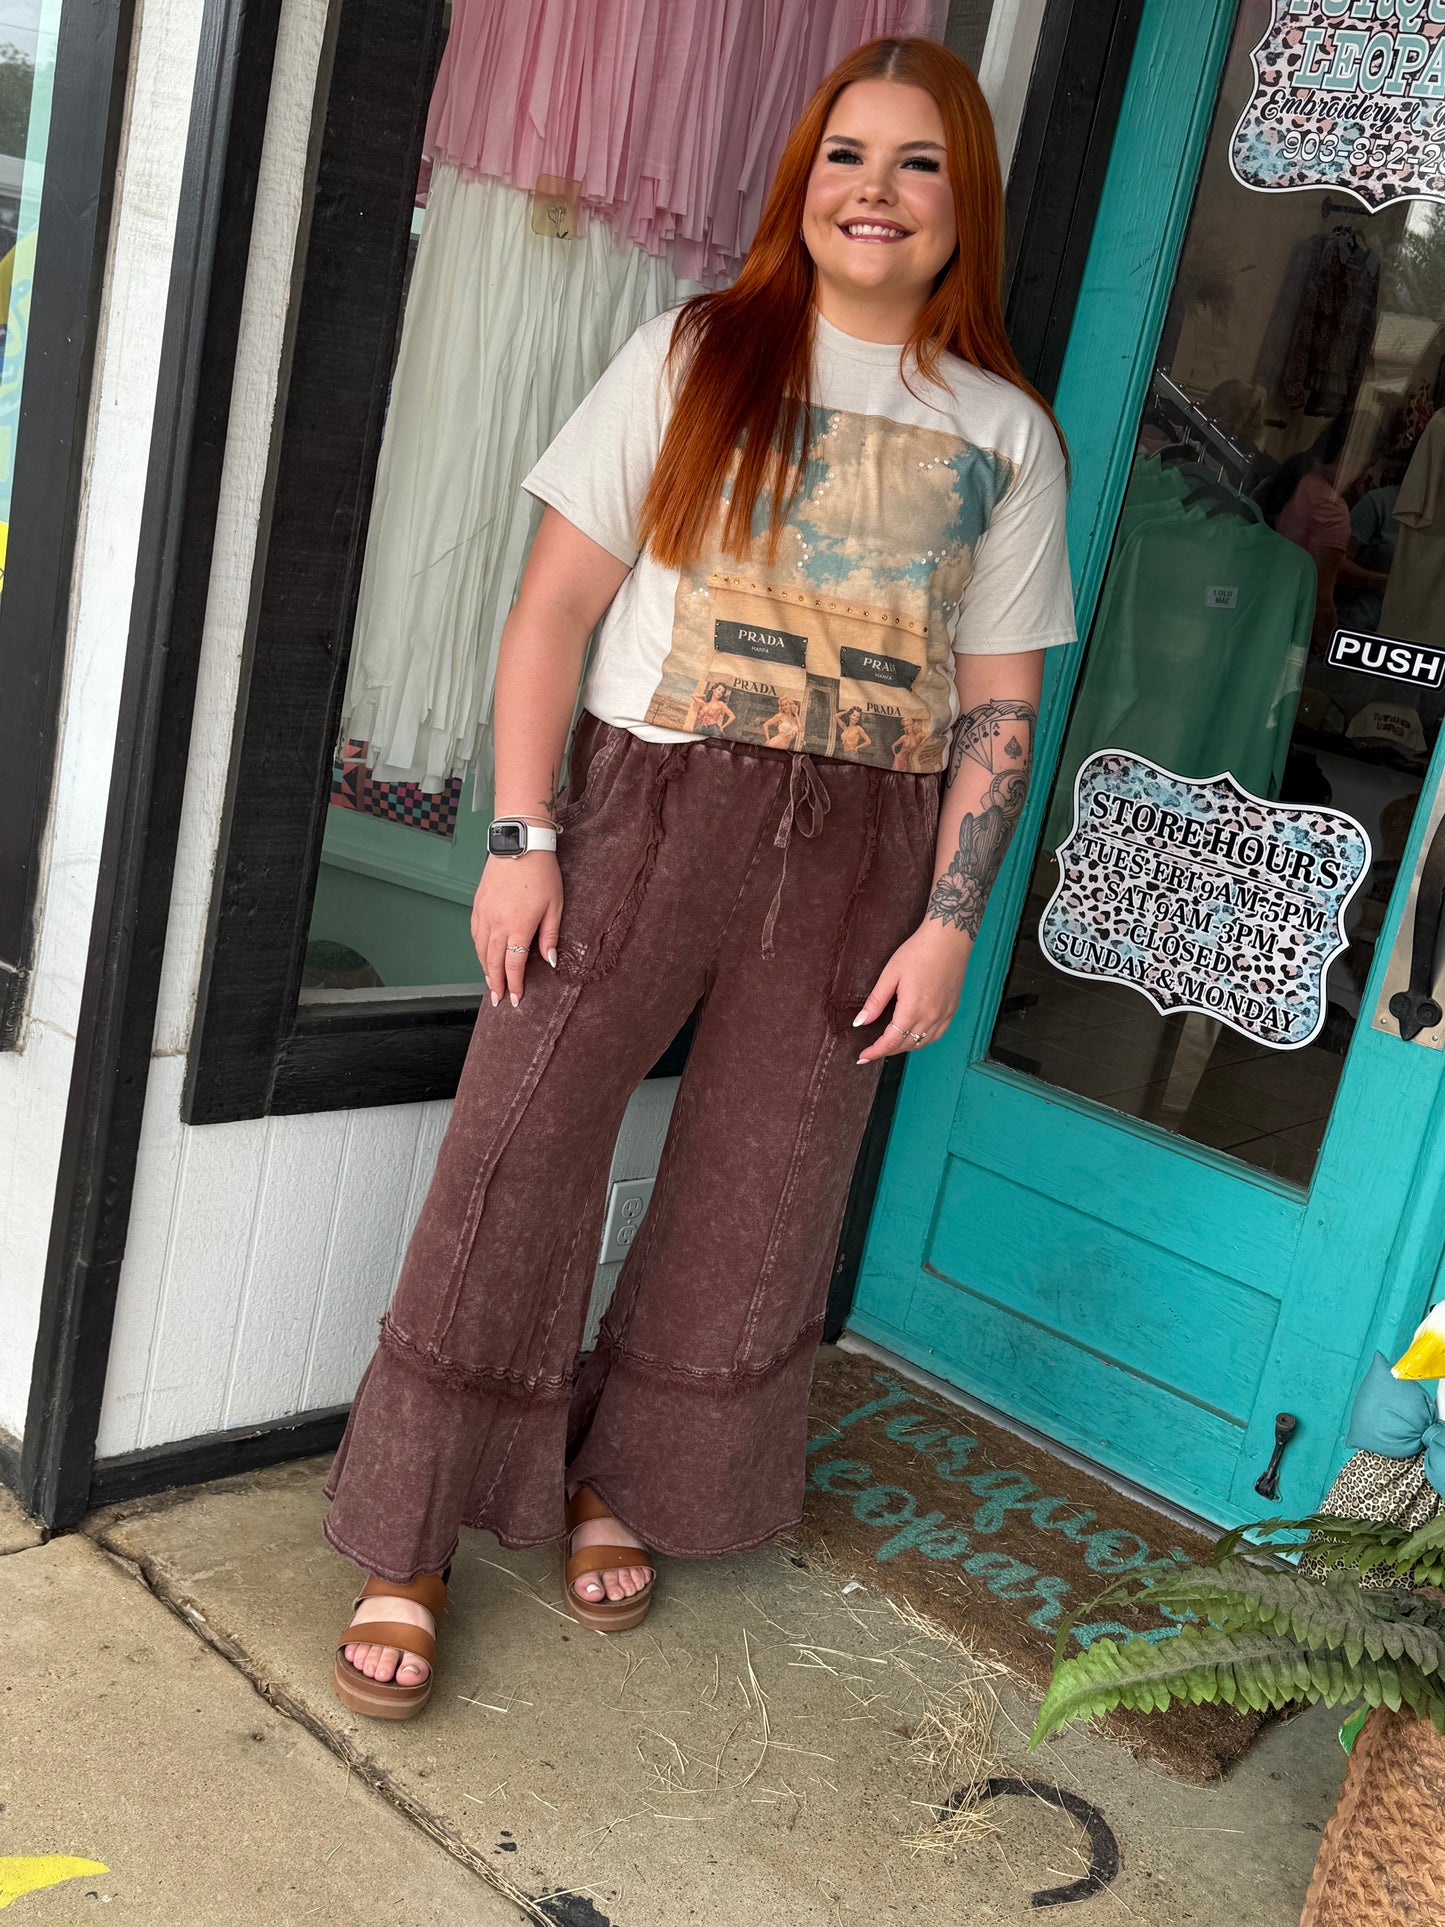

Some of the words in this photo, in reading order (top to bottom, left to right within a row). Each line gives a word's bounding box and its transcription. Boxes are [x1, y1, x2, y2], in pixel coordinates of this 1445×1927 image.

[1260, 89, 1401, 133] Embroidery
[1404, 101, 1422, 134] &
[738, 629, 785, 648] PRADA
[1335, 636, 1440, 681] PUSH
[732, 677, 777, 697] PRADA
[866, 702, 901, 717] PRADA
[1089, 790, 1203, 851] STORE
[1211, 825, 1342, 890] HOURS
[1104, 882, 1153, 912] SAT
[1155, 901, 1278, 955] 9AM-3PM
[1200, 879, 1327, 934] 9AM-5PM
[1129, 924, 1233, 975] CLOSED
[1055, 932, 1153, 983] SUNDAY
[1156, 970, 1176, 991] &
[1180, 976, 1300, 1034] MONDAY
